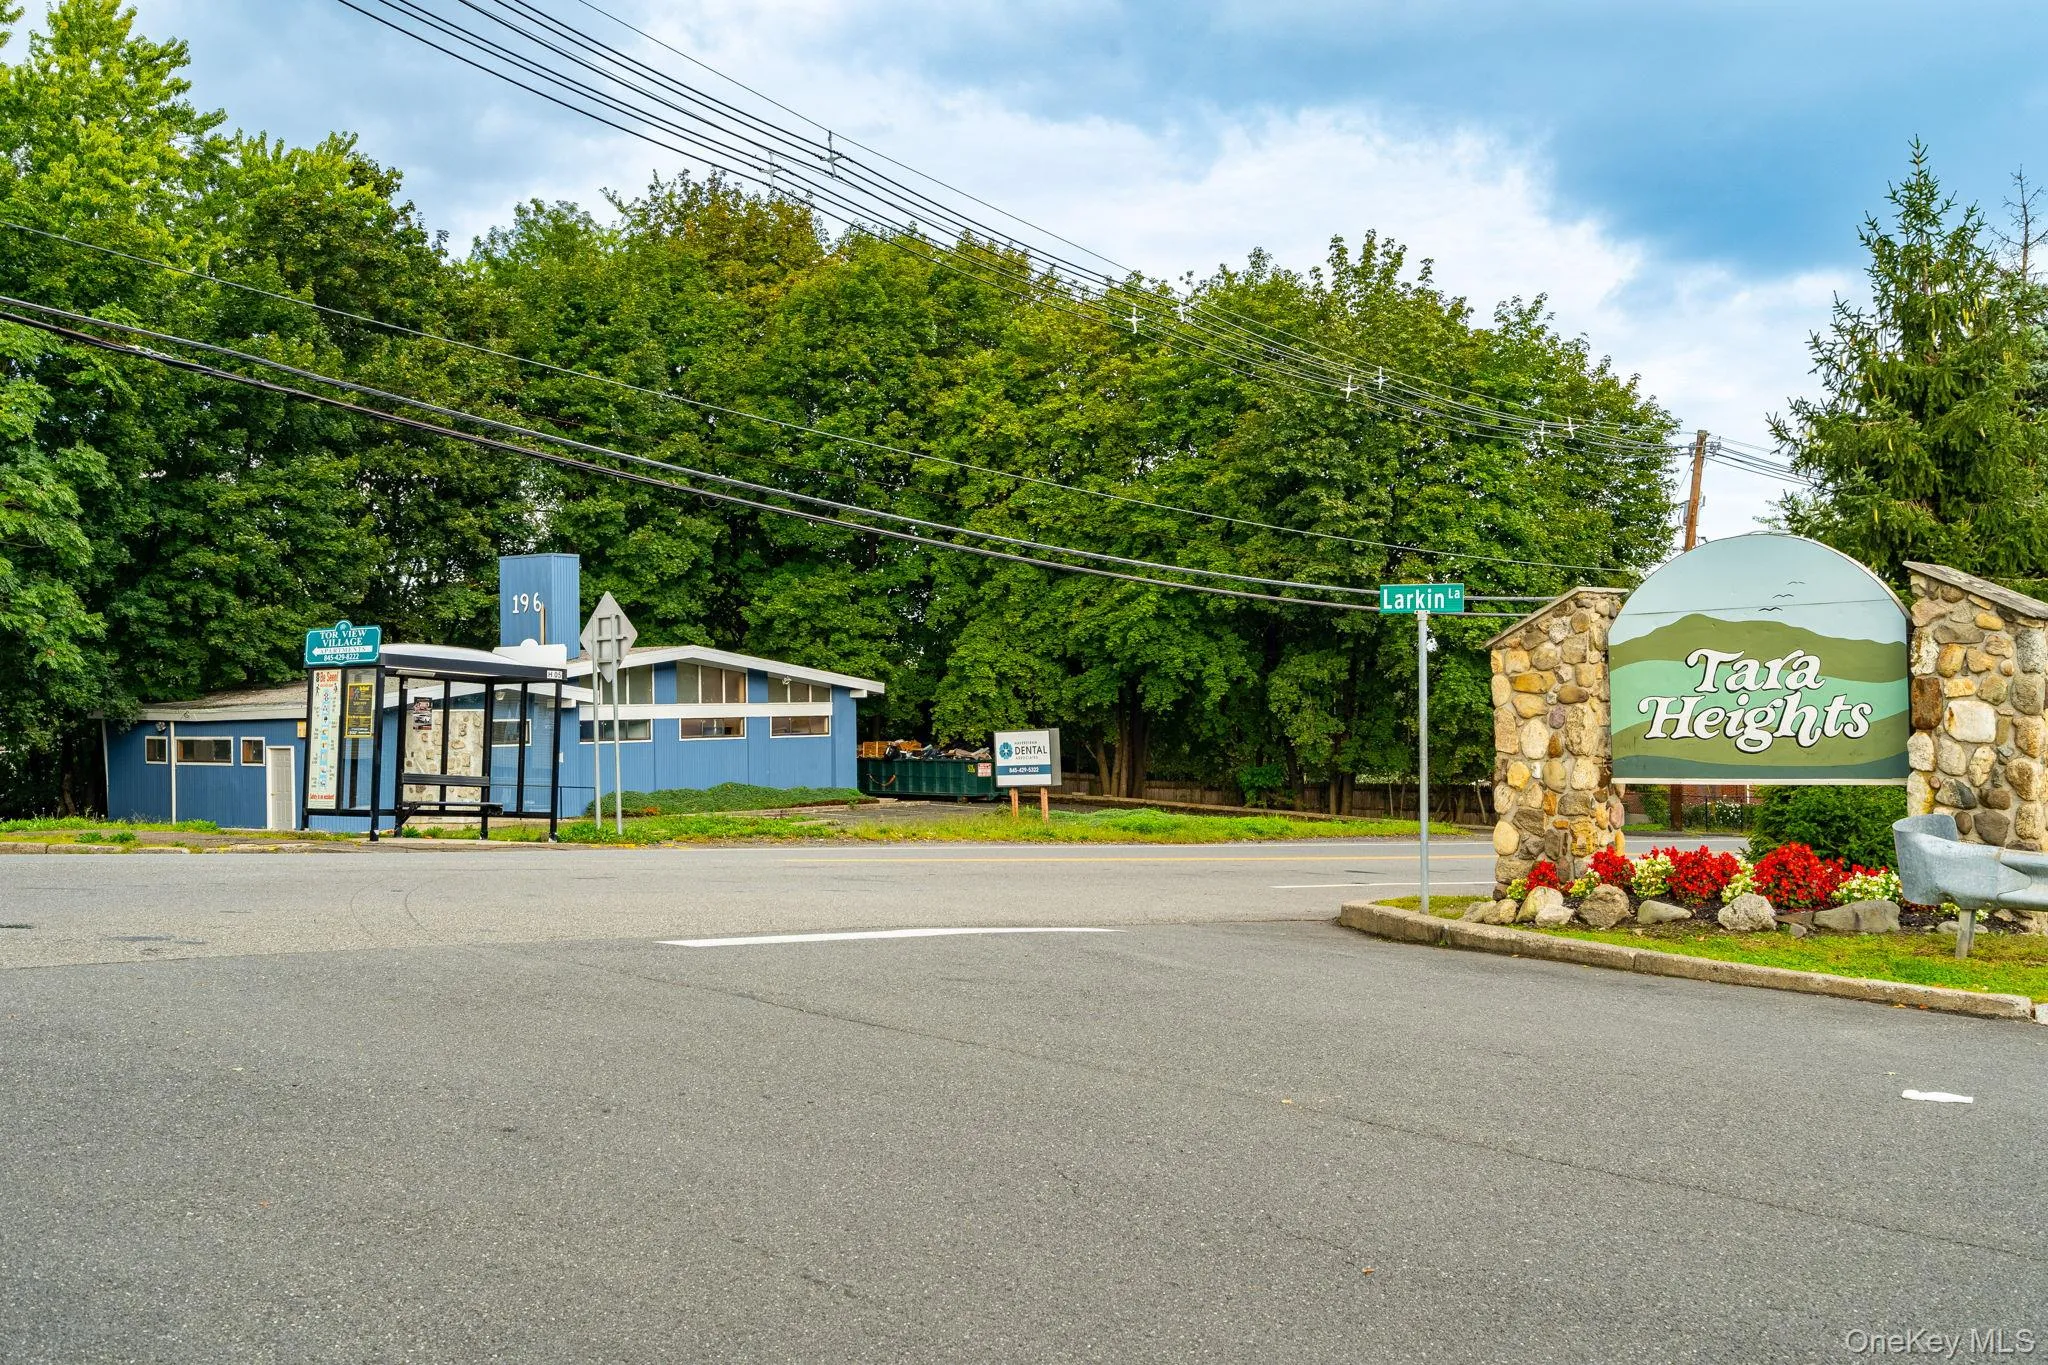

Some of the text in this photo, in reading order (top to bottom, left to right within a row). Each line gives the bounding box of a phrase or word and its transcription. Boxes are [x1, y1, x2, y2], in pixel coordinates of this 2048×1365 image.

[512, 592, 542, 614] 196
[1383, 588, 1460, 609] Larkin La
[320, 629, 367, 639] TOR VIEW
[322, 637, 363, 647] VILLAGE
[1685, 648, 1825, 693] Tara
[1638, 691, 1873, 754] Heights
[1014, 745, 1048, 755] DENTAL
